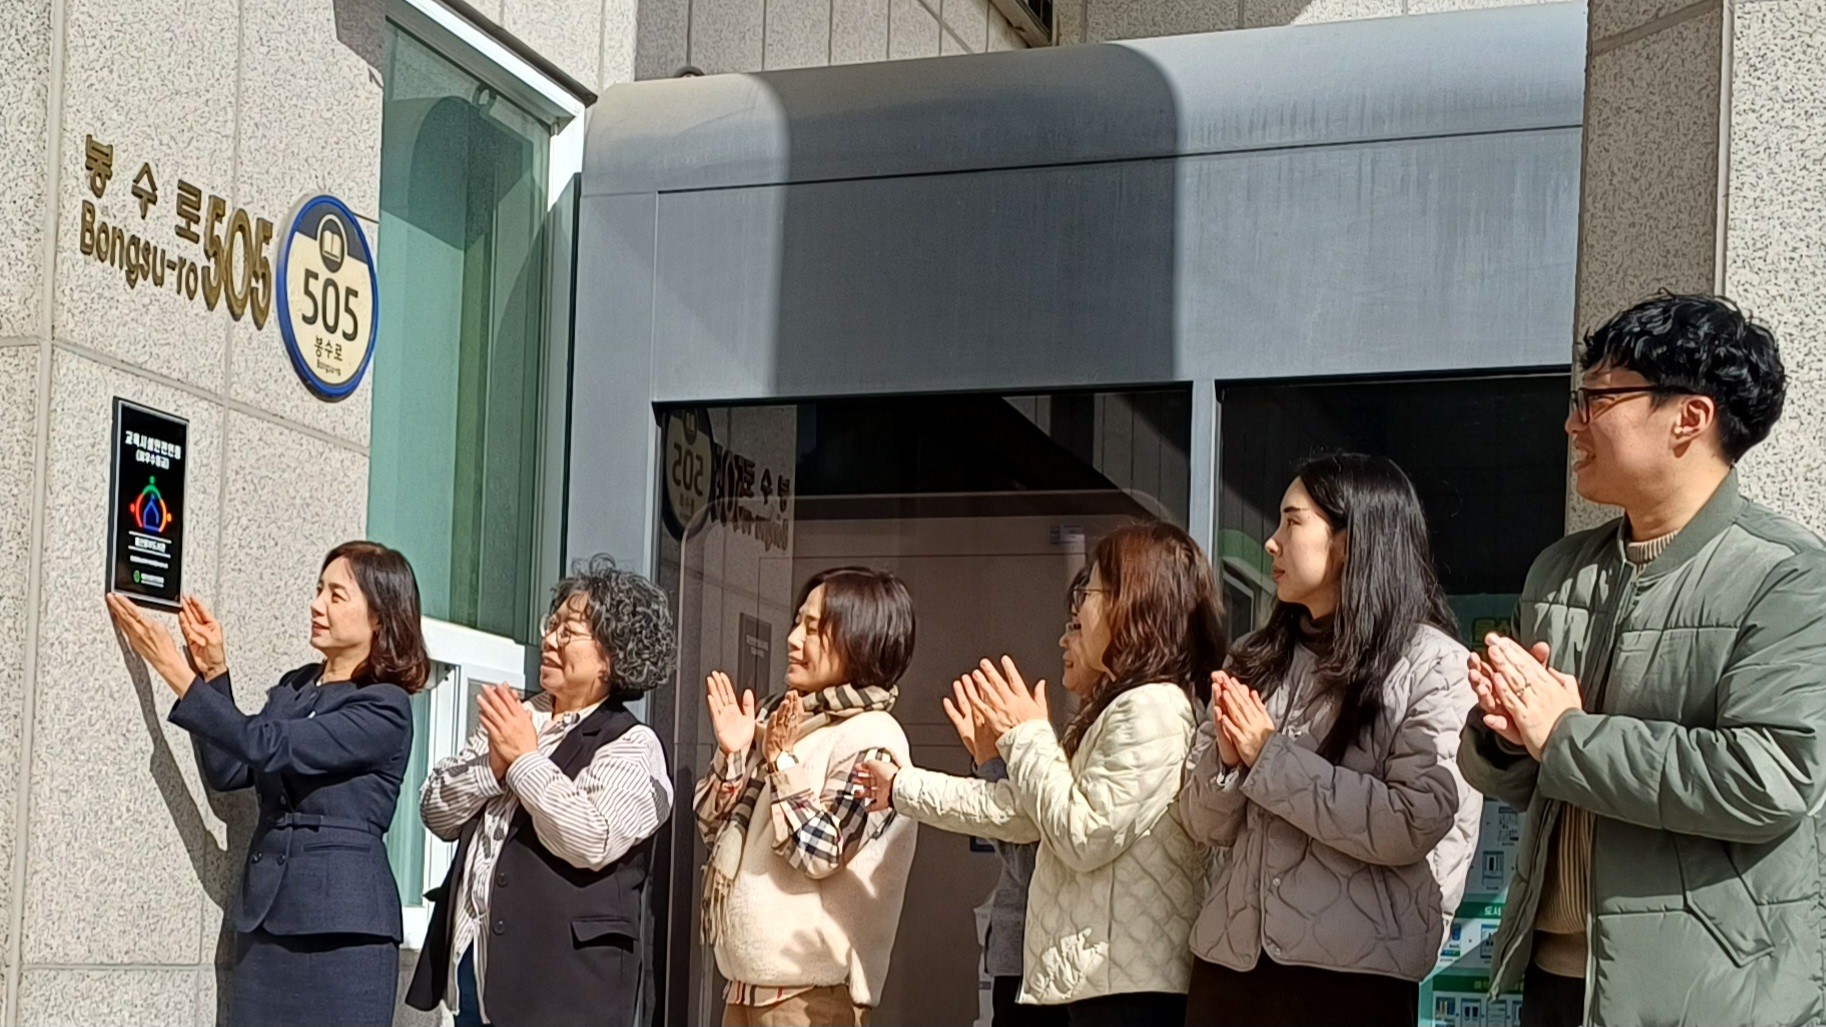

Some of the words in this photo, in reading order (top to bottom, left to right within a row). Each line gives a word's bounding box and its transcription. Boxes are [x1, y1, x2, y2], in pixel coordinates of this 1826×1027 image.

[79, 199, 199, 301] Bongsu-ro
[201, 194, 273, 331] 505
[301, 268, 359, 342] 505
[313, 335, 343, 362] 봉수로
